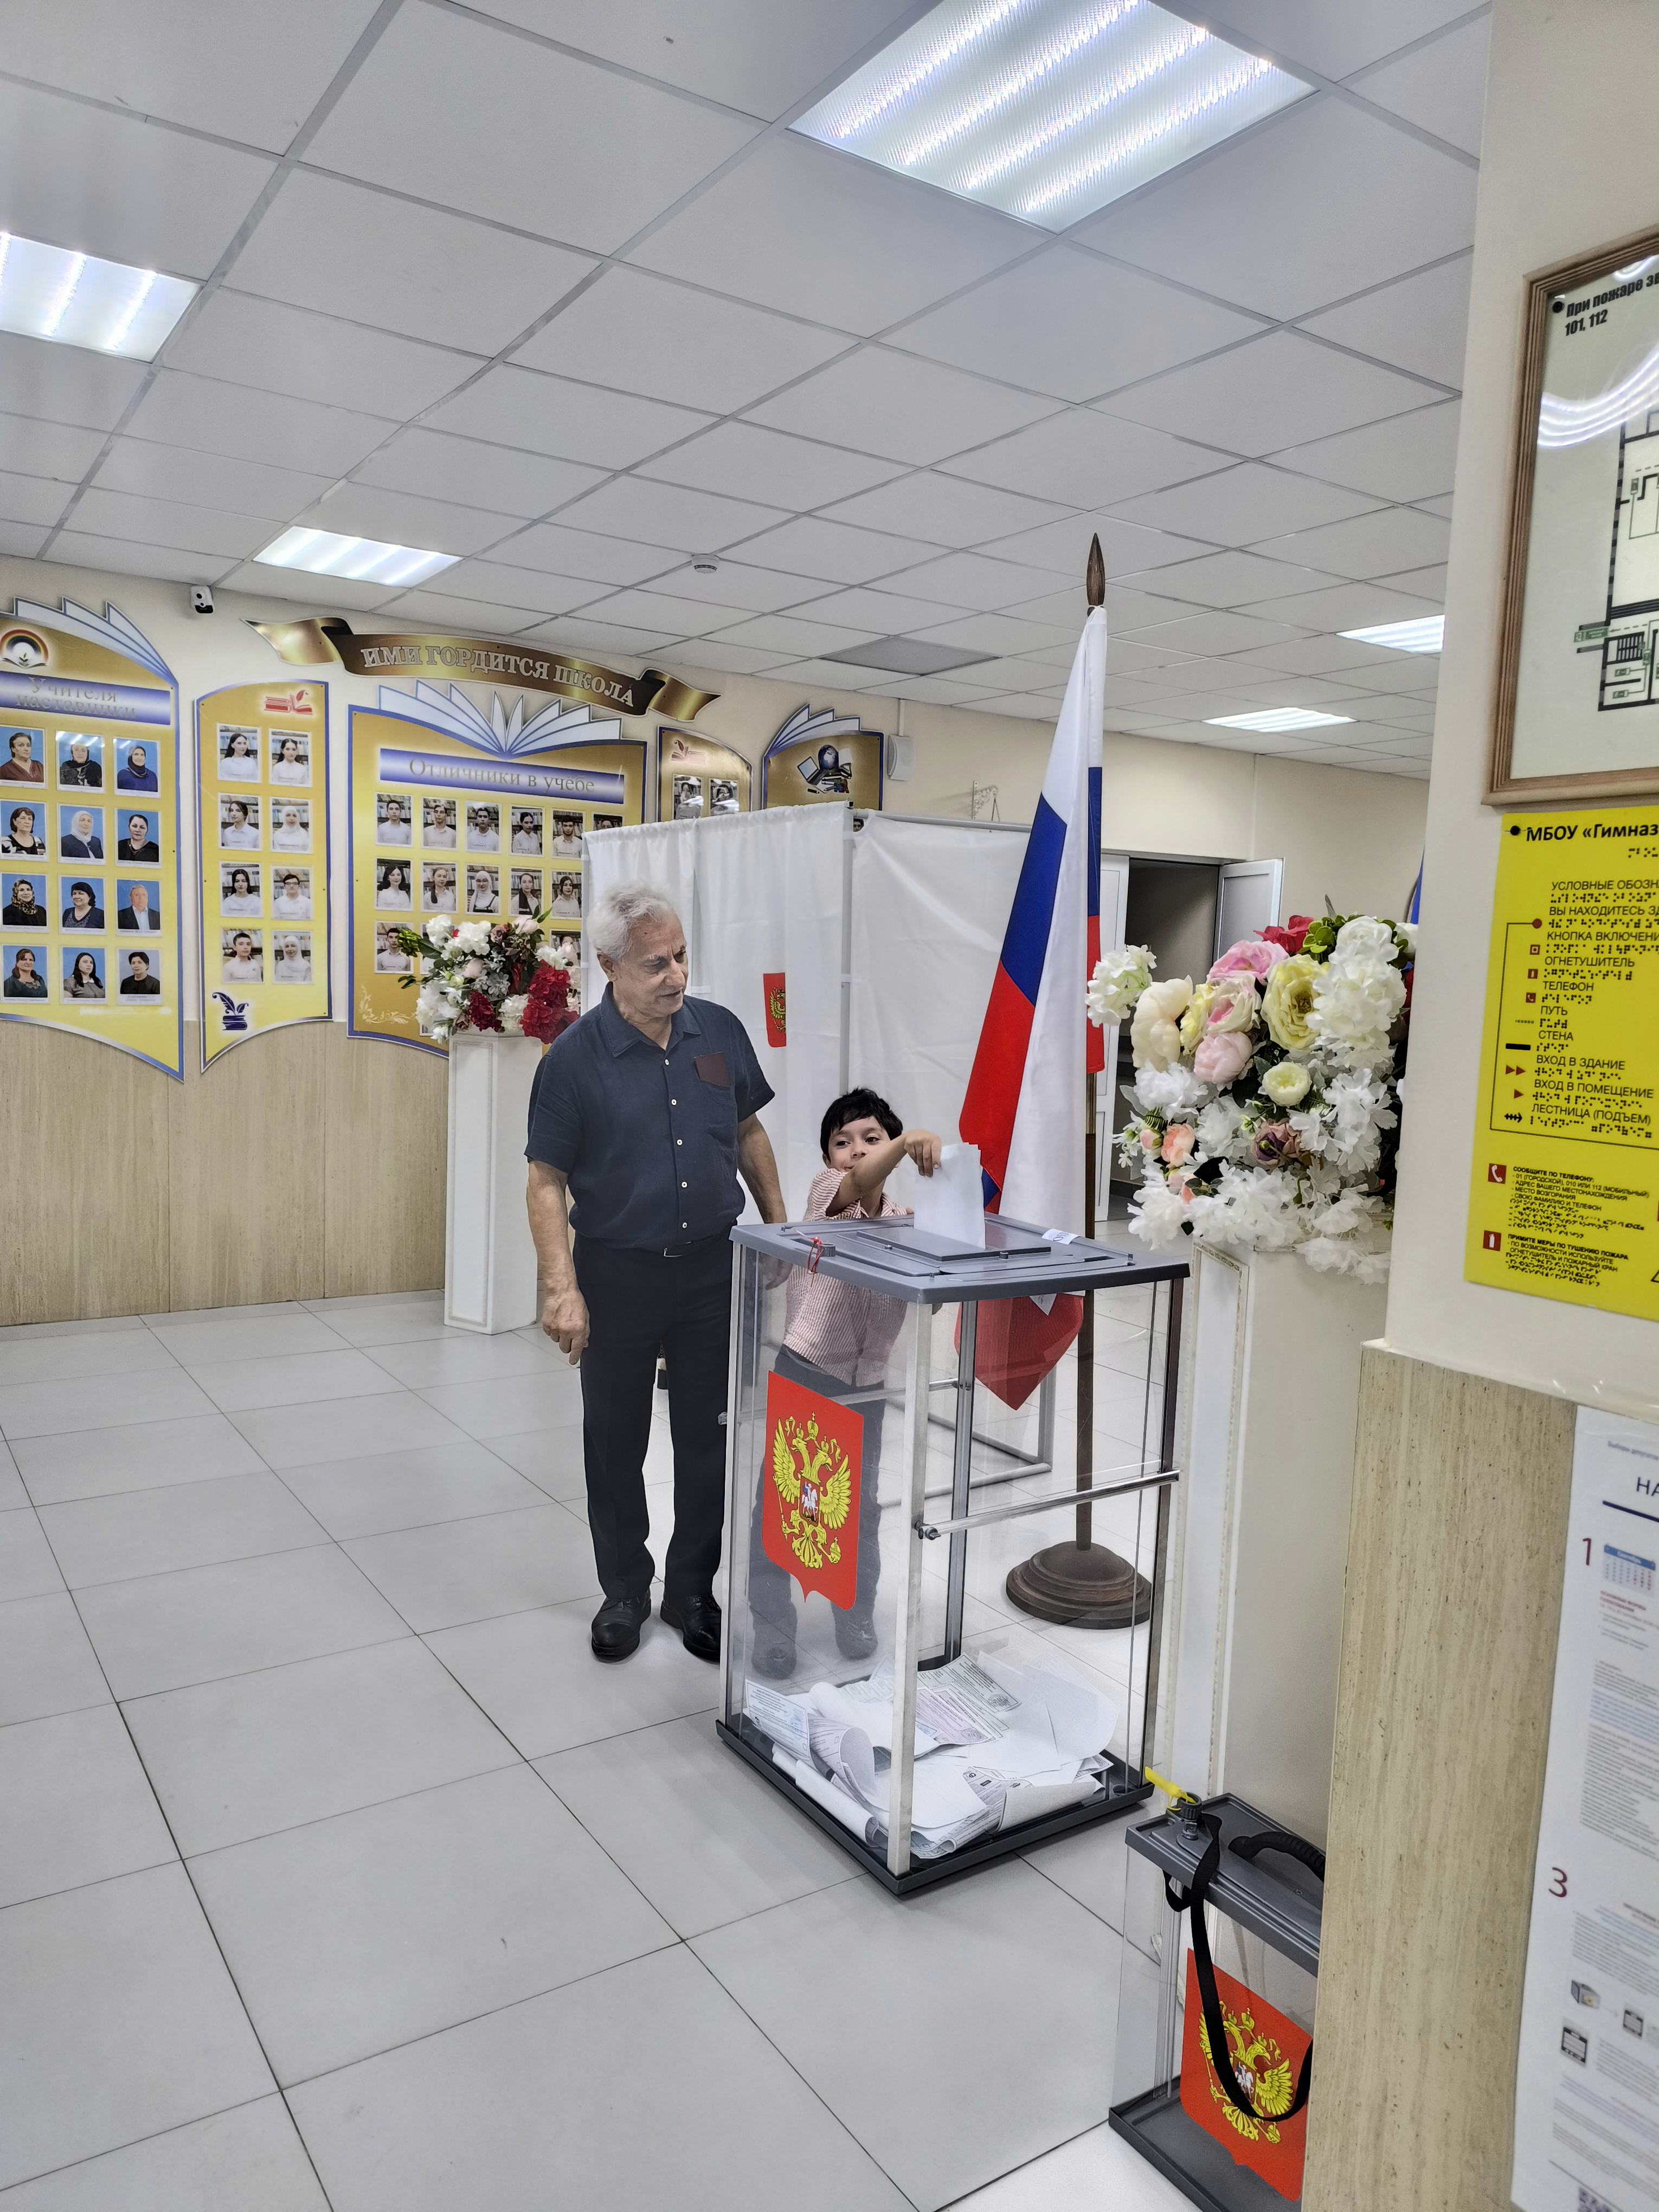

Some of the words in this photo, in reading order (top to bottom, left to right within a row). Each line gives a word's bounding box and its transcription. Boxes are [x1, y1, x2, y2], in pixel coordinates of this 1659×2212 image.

[1566, 299, 1590, 318] При
[1593, 279, 1643, 307] пожаре
[1565, 318, 1585, 336] 101,
[1589, 309, 1608, 327] 112
[361, 646, 422, 668] ИМИ
[427, 646, 550, 679] ГОРДИТСЯ
[554, 665, 634, 706] ШКОЛА
[28, 677, 117, 702] Учителя
[16, 695, 135, 718] наставники
[409, 758, 521, 786] Отличники
[528, 775, 537, 787] в
[543, 775, 595, 794] учёбе
[1526, 825, 1578, 841] МБОУ
[1583, 824, 1658, 838] «Гимназ
[1551, 880, 1614, 891] УСЛОВНЫЕ
[1617, 879, 1659, 890] ОБОЗН
[1549, 906, 1566, 916] ВЫ
[1569, 906, 1645, 916] НАХОДИТЕСЬ
[1547, 931, 1592, 941] КНОПКА
[1545, 956, 1635, 967] ОГНЕТУШИТЕЛЬ
[1542, 981, 1594, 992] ТЕЛЕФОН
[1540, 1006, 1568, 1015] ПУТЬ
[1538, 1030, 1573, 1041] СТЕНА
[1536, 1054, 1566, 1067] ВХОД
[1569, 1057, 1576, 1066] В
[1579, 1058, 1625, 1070] ЗДАНИЕ
[1534, 1079, 1564, 1092] ВХОД
[1567, 1082, 1574, 1091] В
[1577, 1083, 1654, 1098] ПОМЕЩЕНИЕ
[1532, 1103, 1590, 1118] ЛЕСТНИЦА
[1593, 1110, 1651, 1126] (ПОДЪЕМ)
[1513, 1166, 1547, 1175] СООБЩИТЕ
[1559, 1172, 1594, 1182] ТЕЛЕФОНУ:
[1536, 1183, 1560, 1191] ВАШЕГО
[1562, 1187, 1627, 1201] МЕСТОНАХОЖДЕНИЯ
[1536, 1189, 1576, 1200] ВОЗГОРАНИЯ
[1534, 1196, 1565, 1205] ФАМИЛИЮ
[1572, 1201, 1602, 1211] ТЕЛЕФОН
[1508, 1233, 1535, 1243] ПРИМИТЕ
[1538, 1239, 1555, 1247] МЕРЫ
[1567, 1244, 1599, 1255] ТУШЕНИЮ
[1601, 1250, 1628, 1260] ПОЖАРА
[1521, 1243, 1567, 1255] ВОЗМОЖНОСТИ
[1568, 1251, 1613, 1264] ИСПОЛЬЗУЙТЕ
[1510, 1247, 1556, 1261] ОГНЕТУШИТЕЛЬ
[1564, 1257, 1600, 1268] ПОЖАРНЫЙ
[1582, 1538, 1591, 1566] 1
[1548, 1867, 1567, 1898] 3
